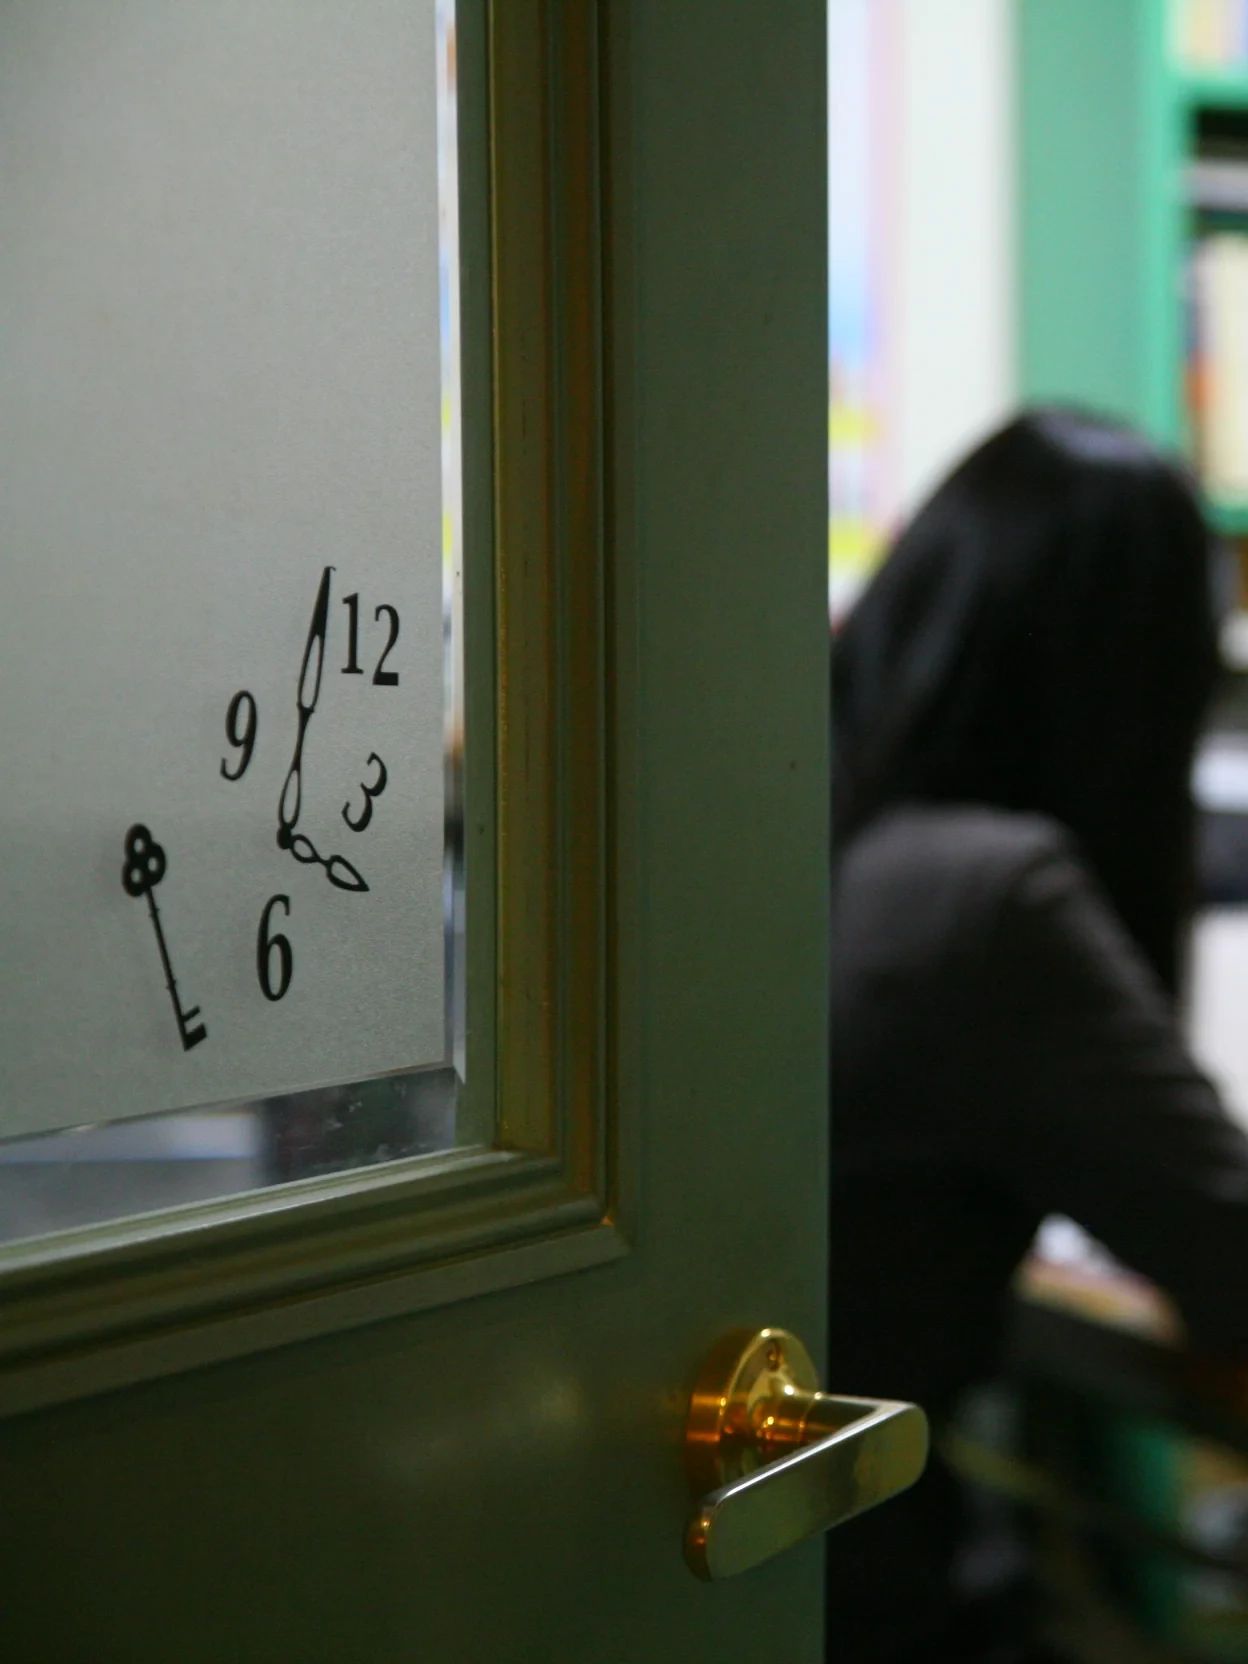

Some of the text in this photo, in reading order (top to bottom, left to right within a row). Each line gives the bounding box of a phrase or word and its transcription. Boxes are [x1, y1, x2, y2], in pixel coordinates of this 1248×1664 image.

[341, 592, 399, 686] 12
[220, 690, 258, 781] 9
[341, 752, 388, 832] 3
[256, 894, 293, 1002] 6
